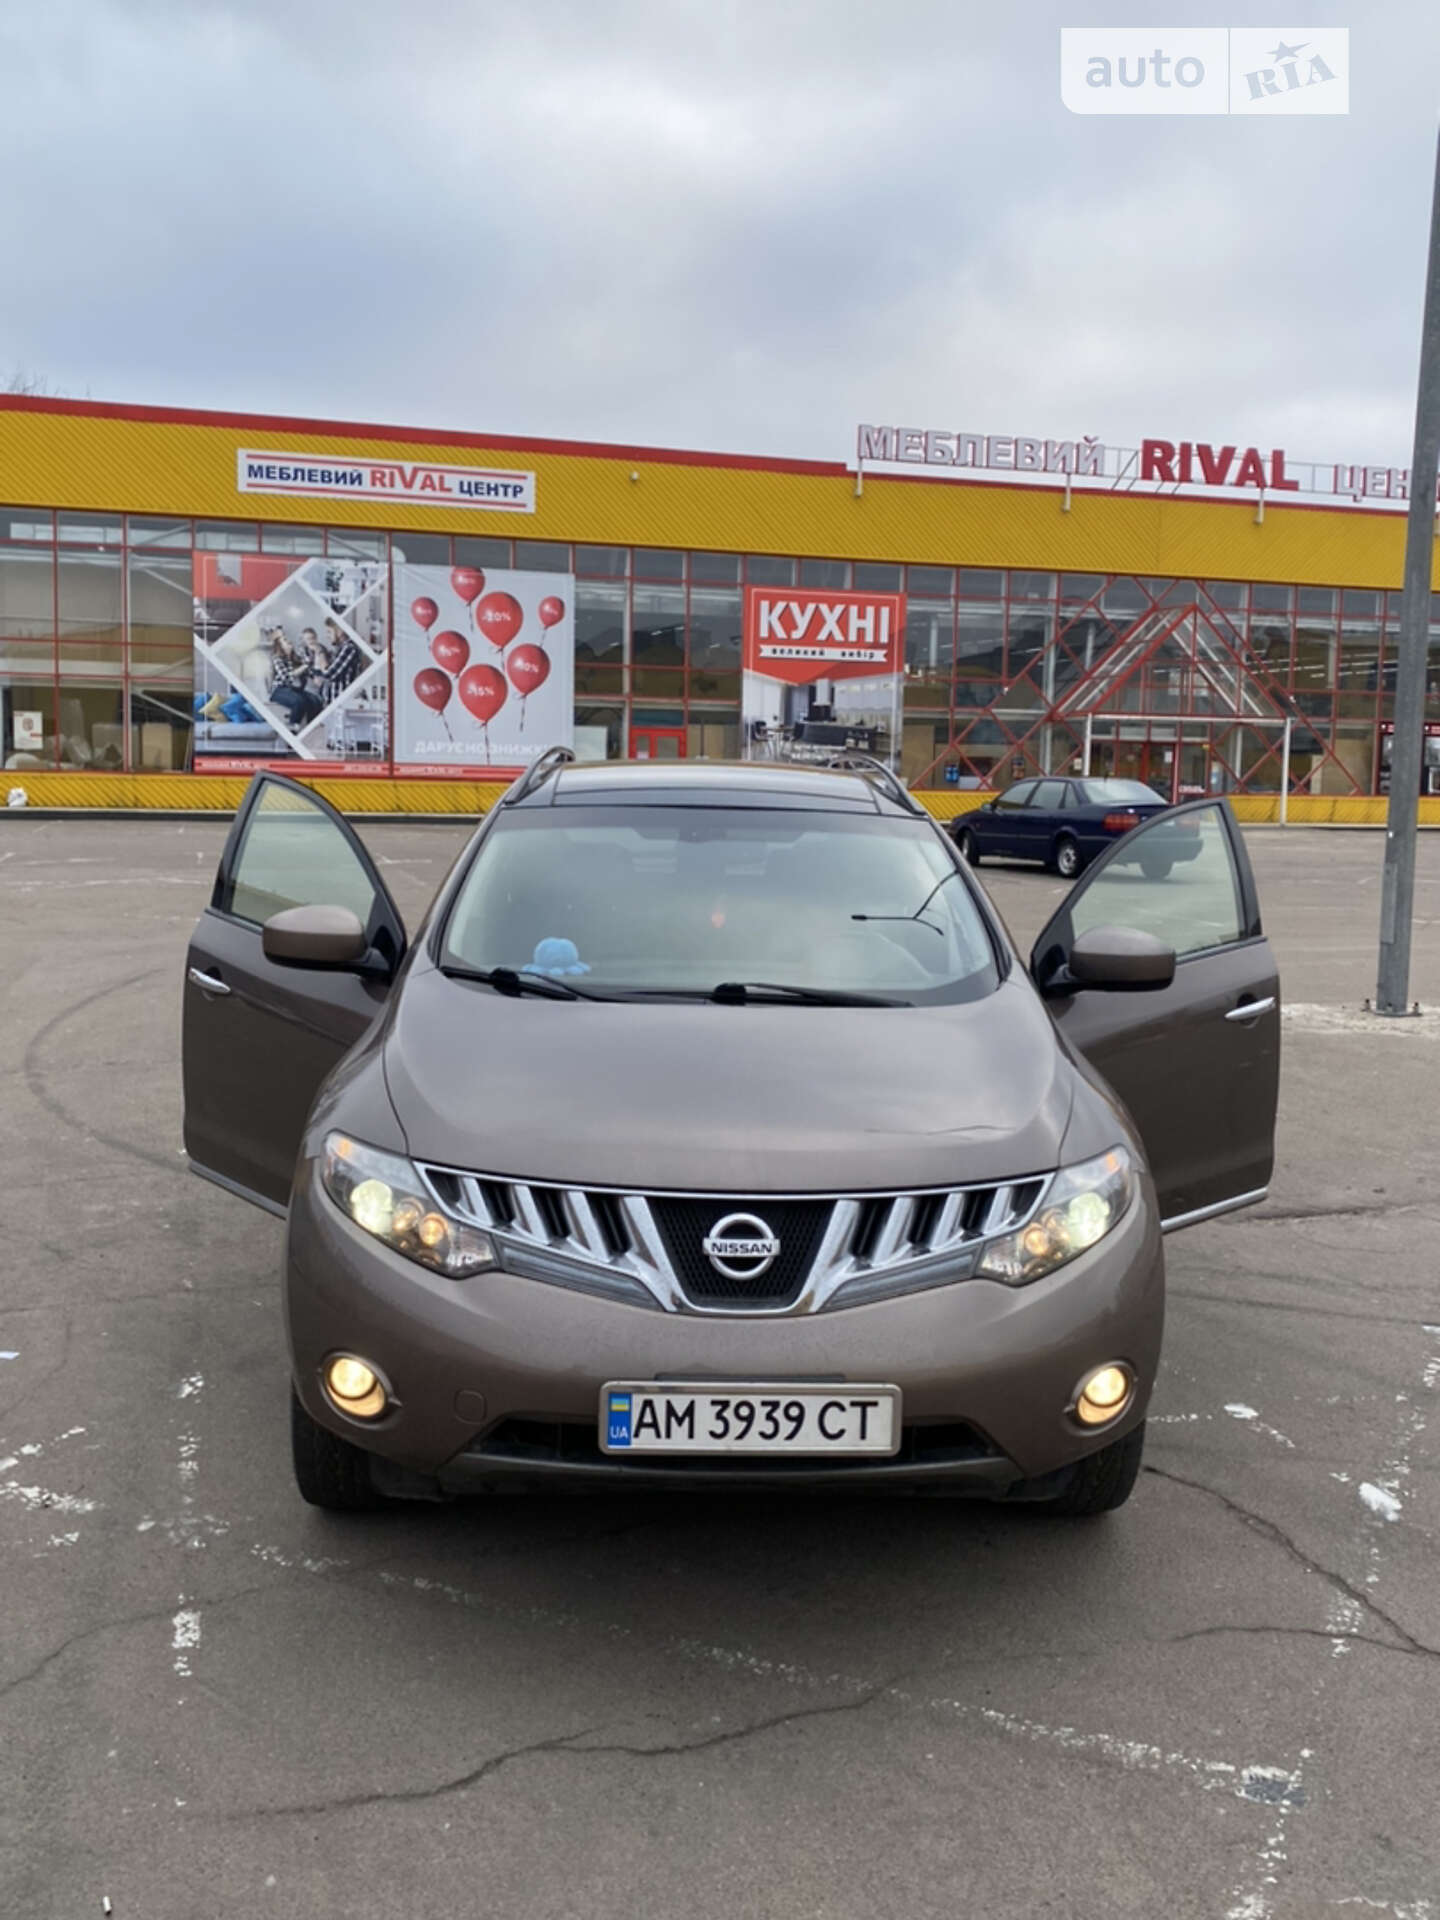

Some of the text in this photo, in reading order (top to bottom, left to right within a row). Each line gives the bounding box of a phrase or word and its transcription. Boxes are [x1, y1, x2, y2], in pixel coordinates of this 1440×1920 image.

[858, 424, 1105, 476] МЕБЛЕВИЙ
[1142, 438, 1299, 492] RIVAL
[248, 464, 363, 486] МЕБЛЕВИЙ
[459, 480, 524, 498] ЦЕНТР
[760, 600, 890, 644] КУХНІ
[711, 1242, 772, 1253] NISSAN
[610, 1425, 629, 1439] UA
[633, 1399, 879, 1441] AM 3939 CT
